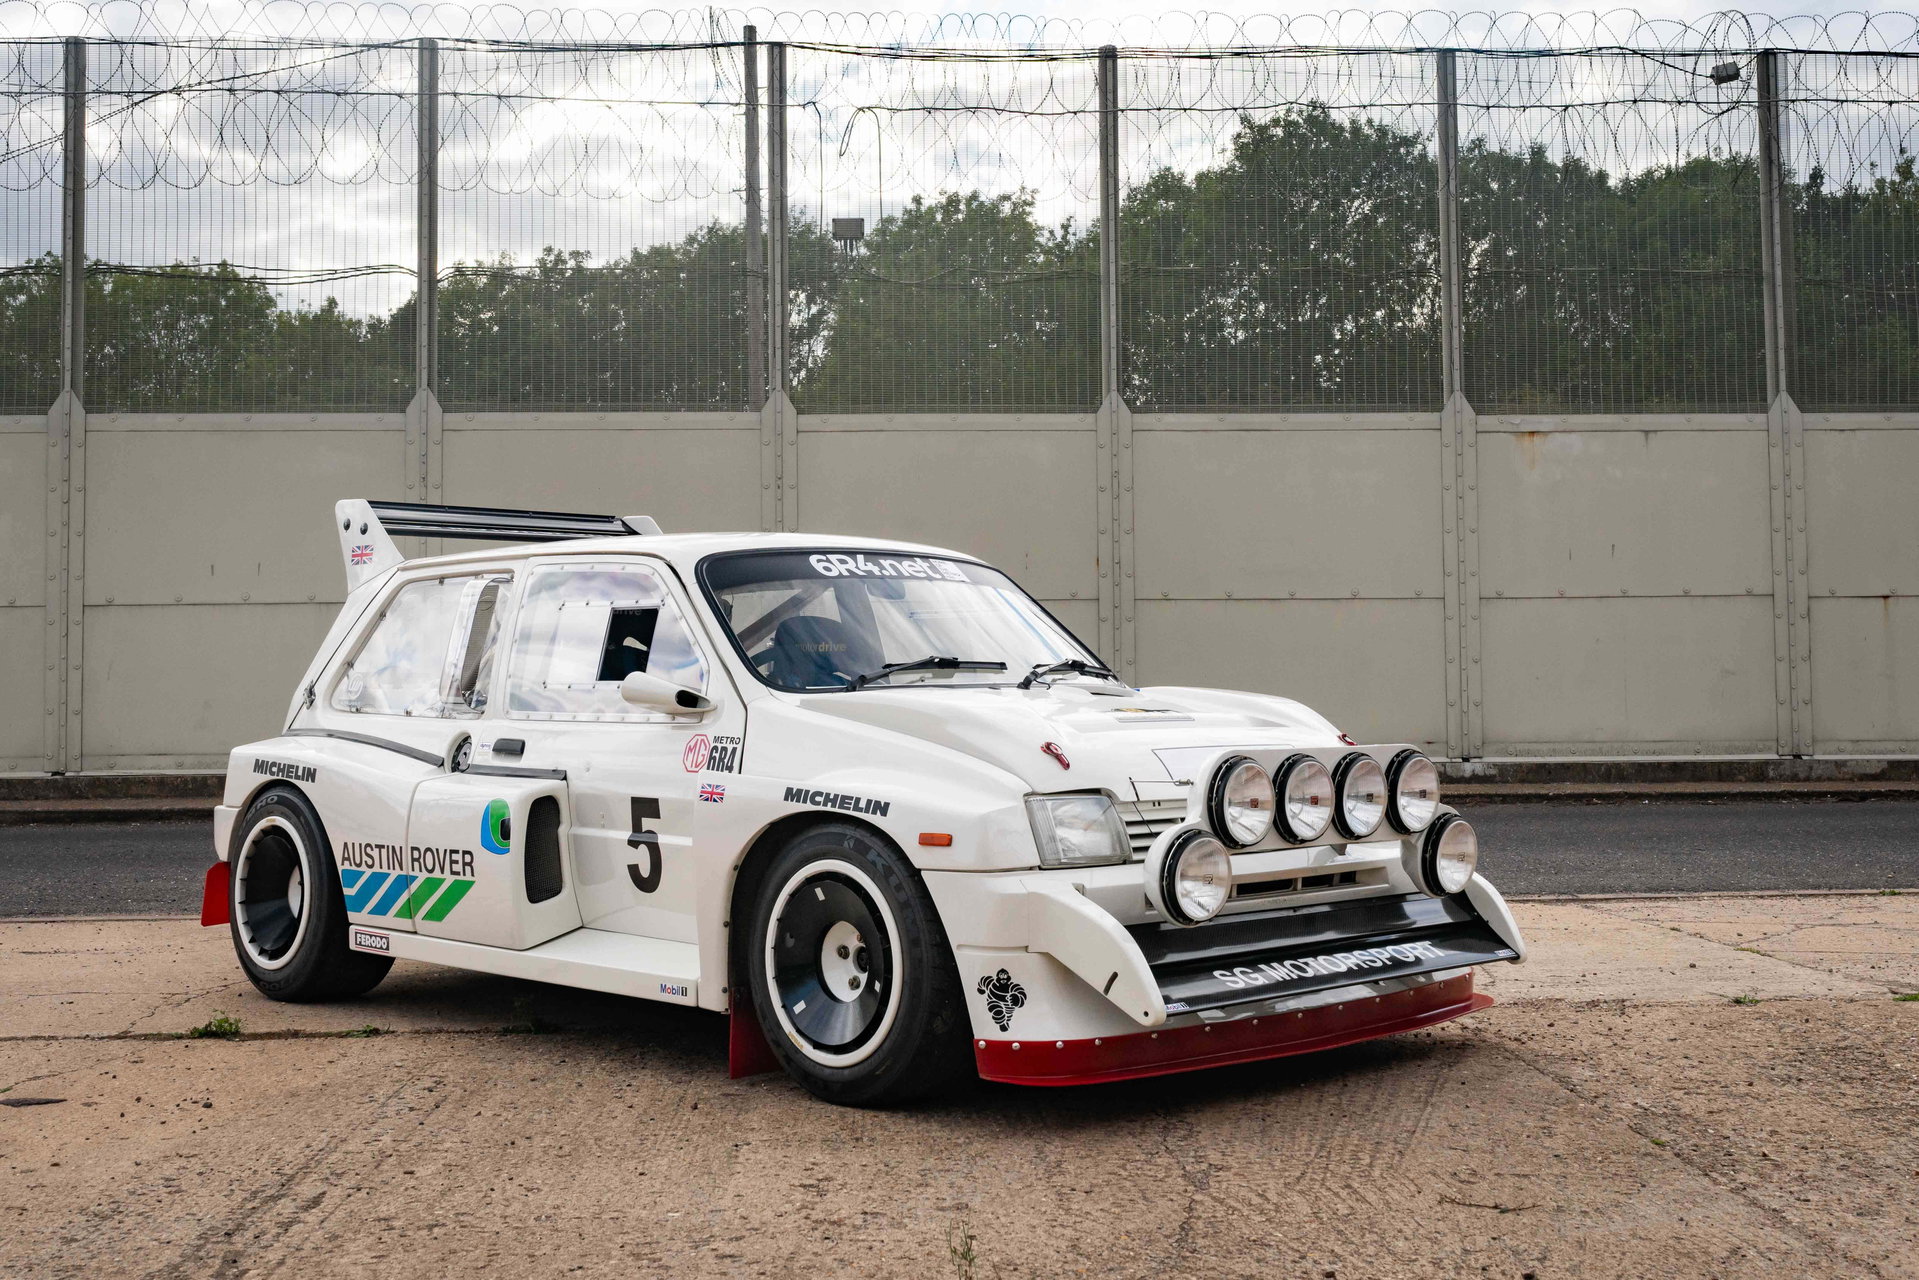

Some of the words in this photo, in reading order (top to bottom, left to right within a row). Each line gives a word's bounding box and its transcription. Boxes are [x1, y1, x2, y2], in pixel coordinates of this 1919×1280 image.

[809, 554, 942, 579] 6R4.net
[685, 737, 708, 770] MG
[712, 736, 741, 746] METRO
[253, 759, 317, 783] MICHELIN
[706, 745, 738, 774] 6R4
[783, 787, 891, 817] MICHELIN
[627, 796, 662, 893] 5
[341, 842, 404, 871] AUSTIN
[410, 846, 475, 877] ROVER
[356, 933, 388, 950] FERODO
[1212, 967, 1267, 989] SG
[1257, 941, 1446, 981] MOTORSPORT
[660, 983, 681, 996] Mobil
